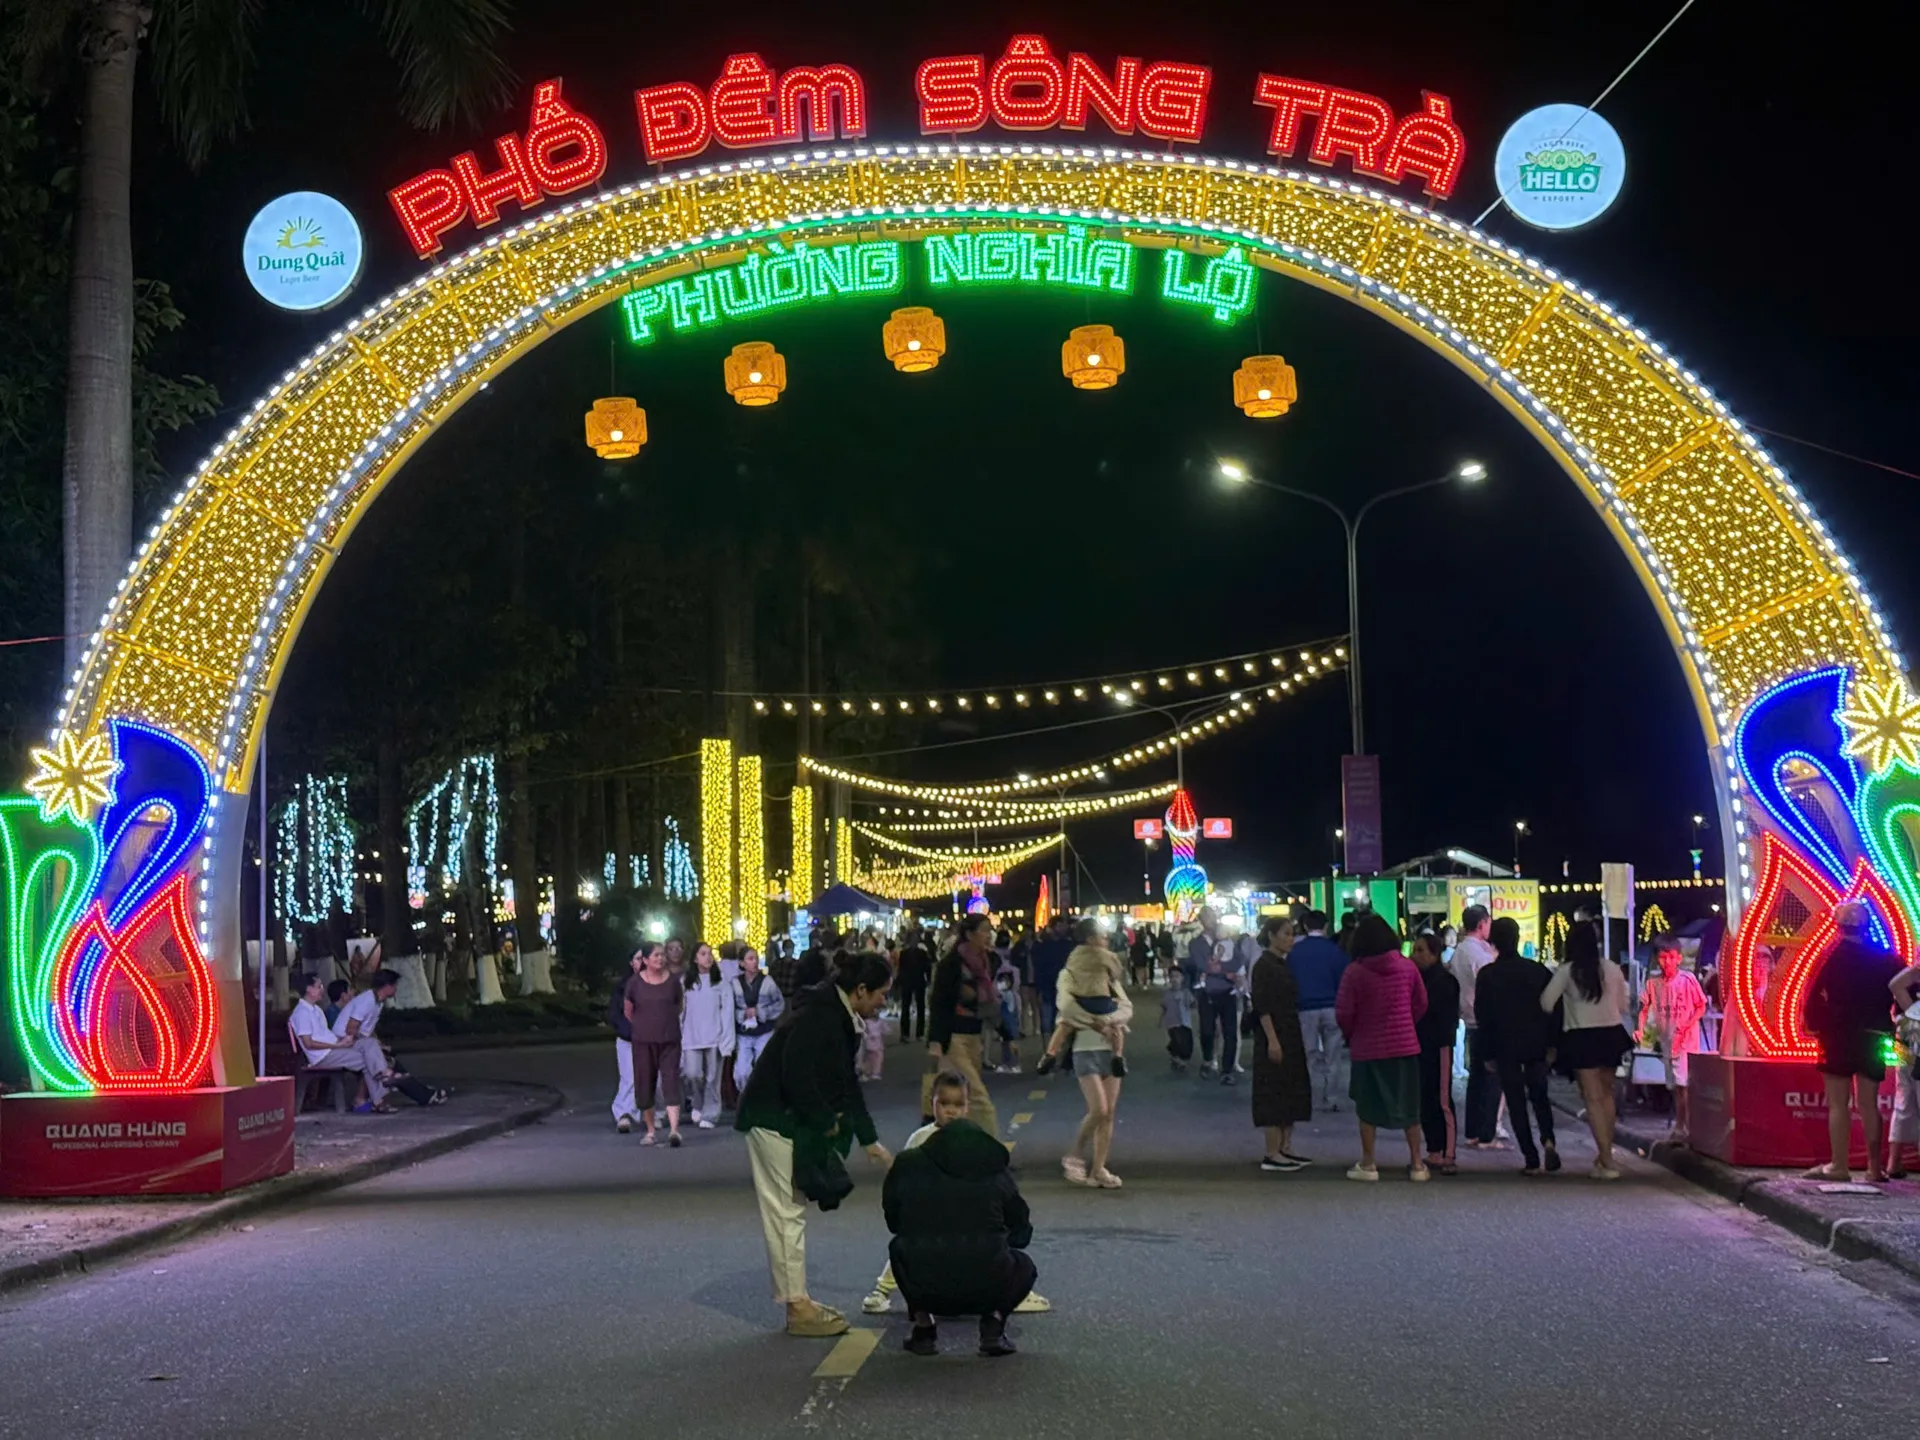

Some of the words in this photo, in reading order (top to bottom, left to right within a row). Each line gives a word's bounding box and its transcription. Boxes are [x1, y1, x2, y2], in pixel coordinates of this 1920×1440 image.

[388, 77, 607, 262] PHỐ
[915, 34, 1212, 144] SÔNG
[1253, 72, 1467, 201] TRÀ
[1525, 171, 1597, 190] HELLO
[258, 255, 304, 272] Dung
[620, 239, 902, 344] PHƯỜNG
[924, 223, 1135, 292] NGHĨA
[1162, 243, 1257, 324] LỘ
[45, 1123, 122, 1139] QUANG
[52, 1141, 99, 1150] PROFESSIONAL
[145, 1139, 179, 1148] COMPANY
